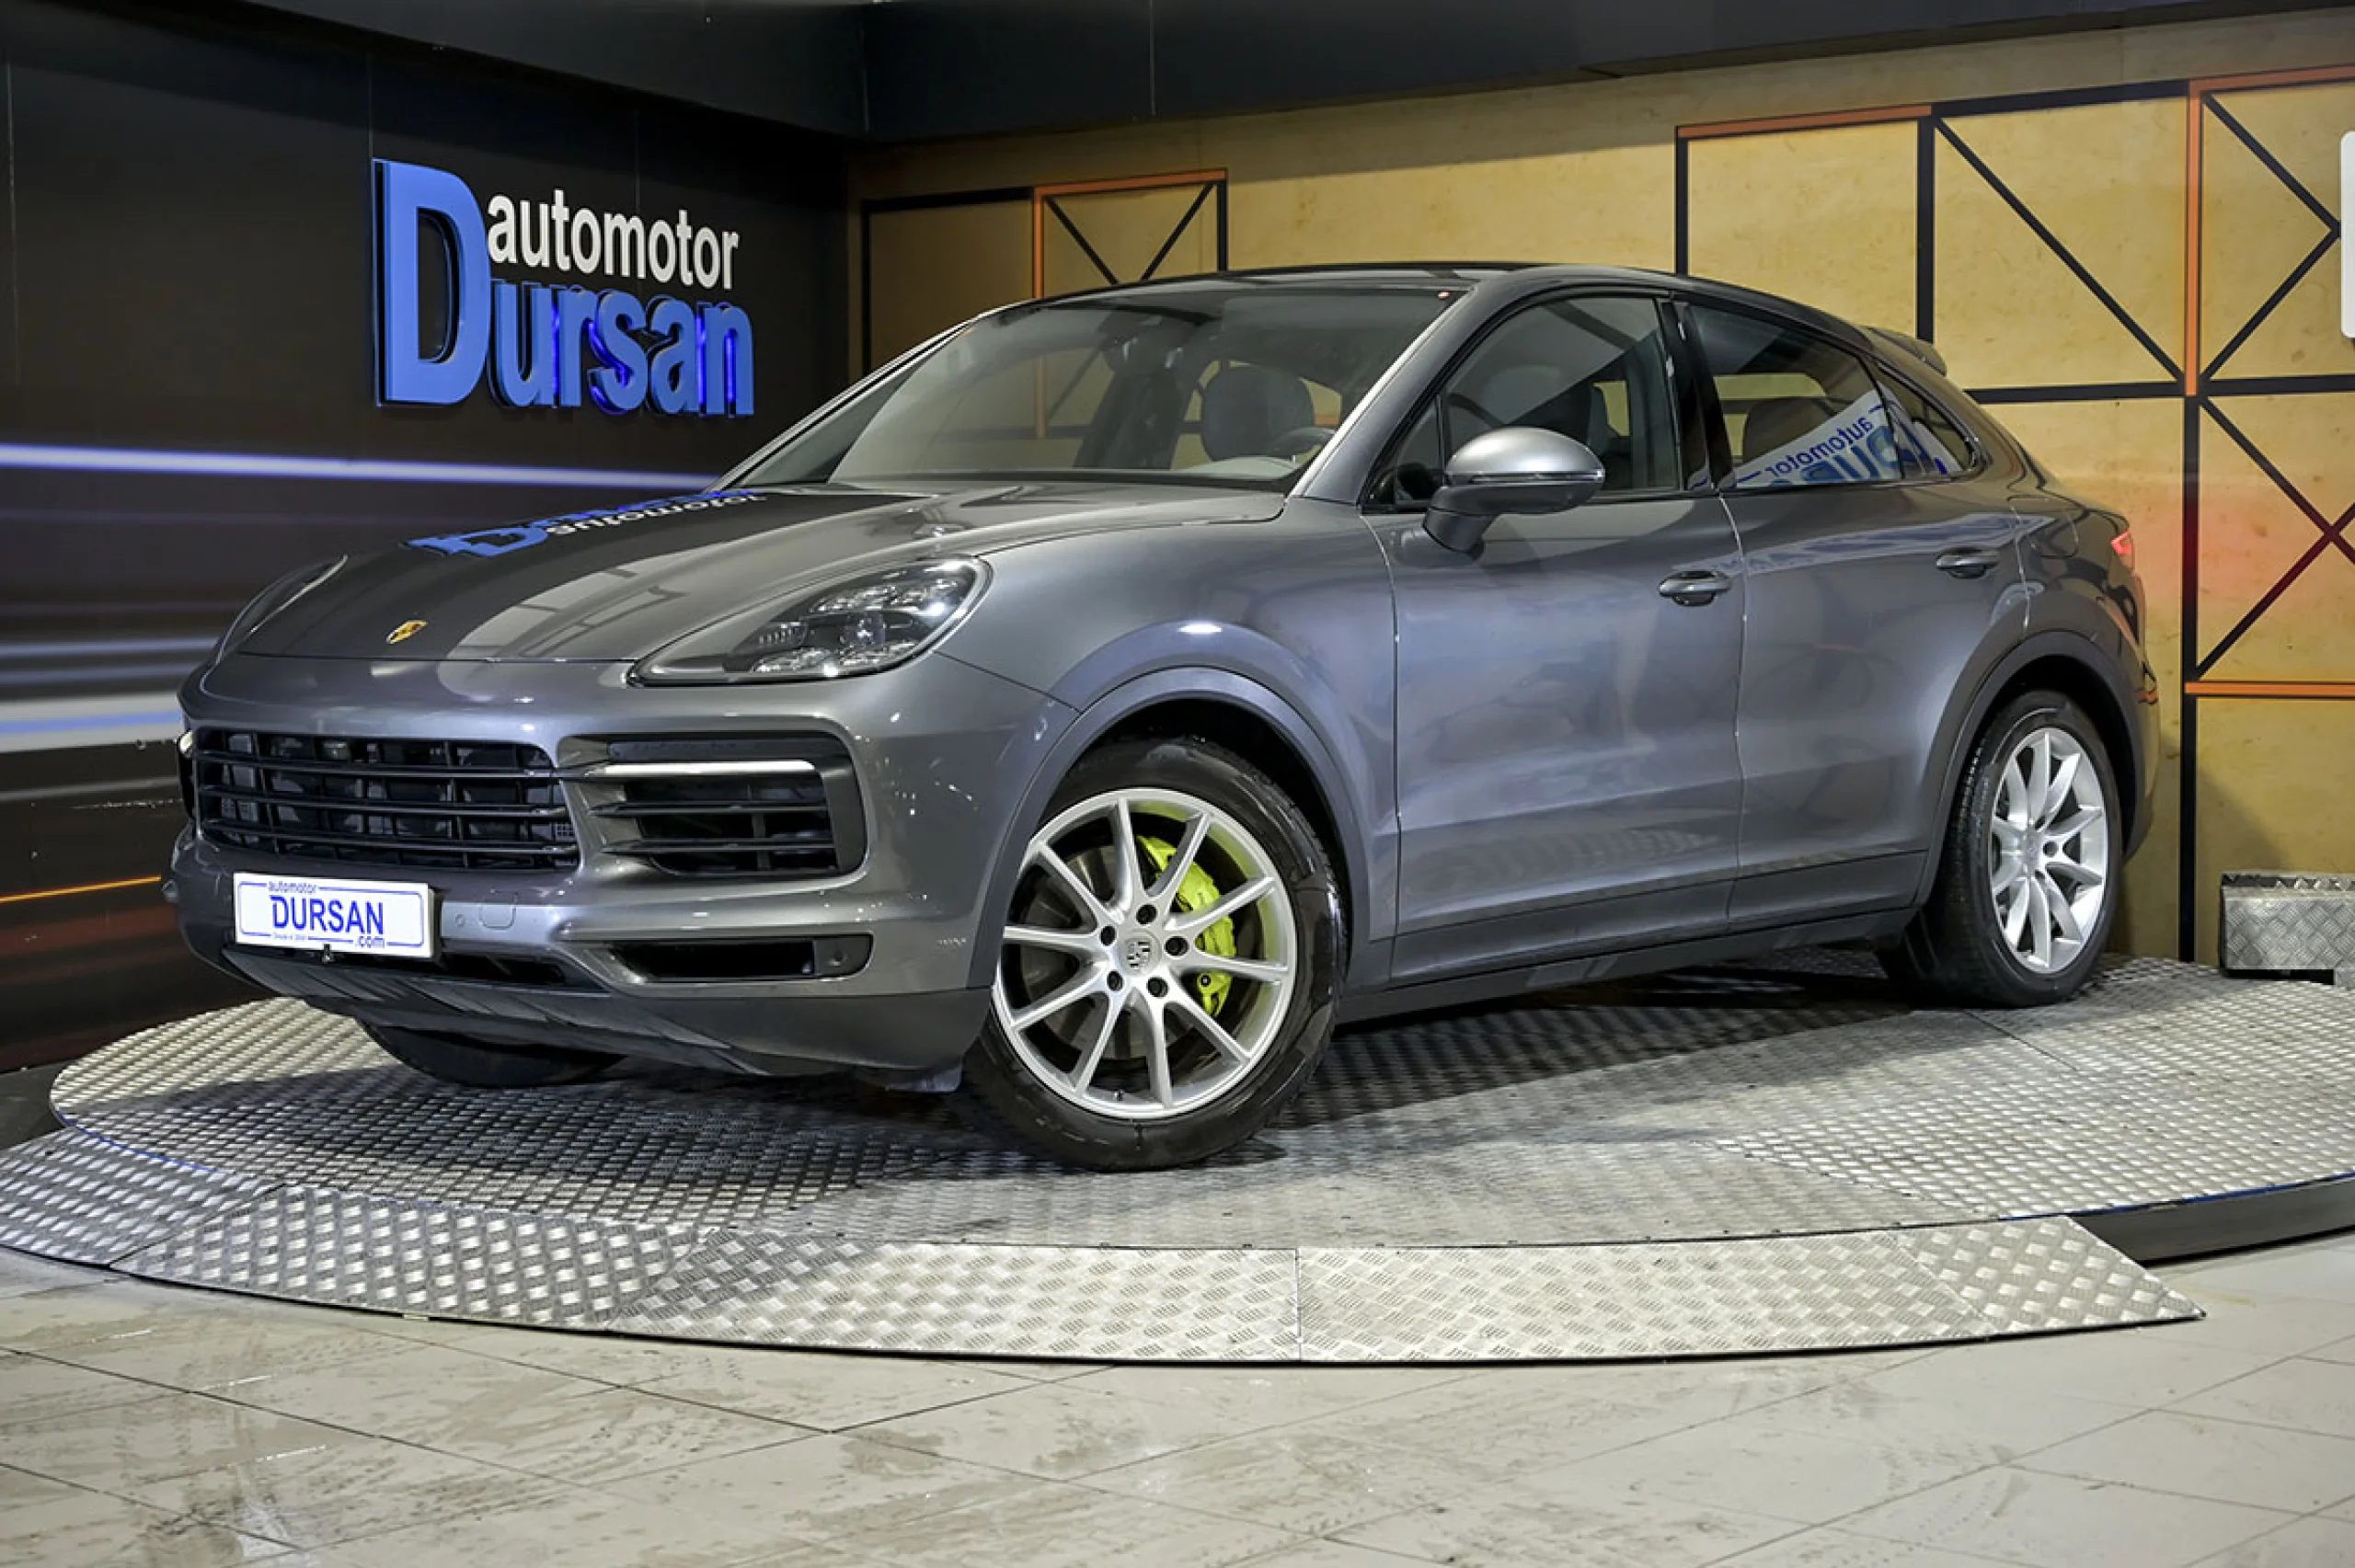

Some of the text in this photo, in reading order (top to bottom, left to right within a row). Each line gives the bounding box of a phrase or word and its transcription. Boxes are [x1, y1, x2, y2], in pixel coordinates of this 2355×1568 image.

[488, 189, 739, 290] automotor
[373, 158, 754, 417] Dursan
[269, 881, 317, 894] automotor
[270, 895, 385, 935] DURSAN
[355, 936, 385, 949] .com
